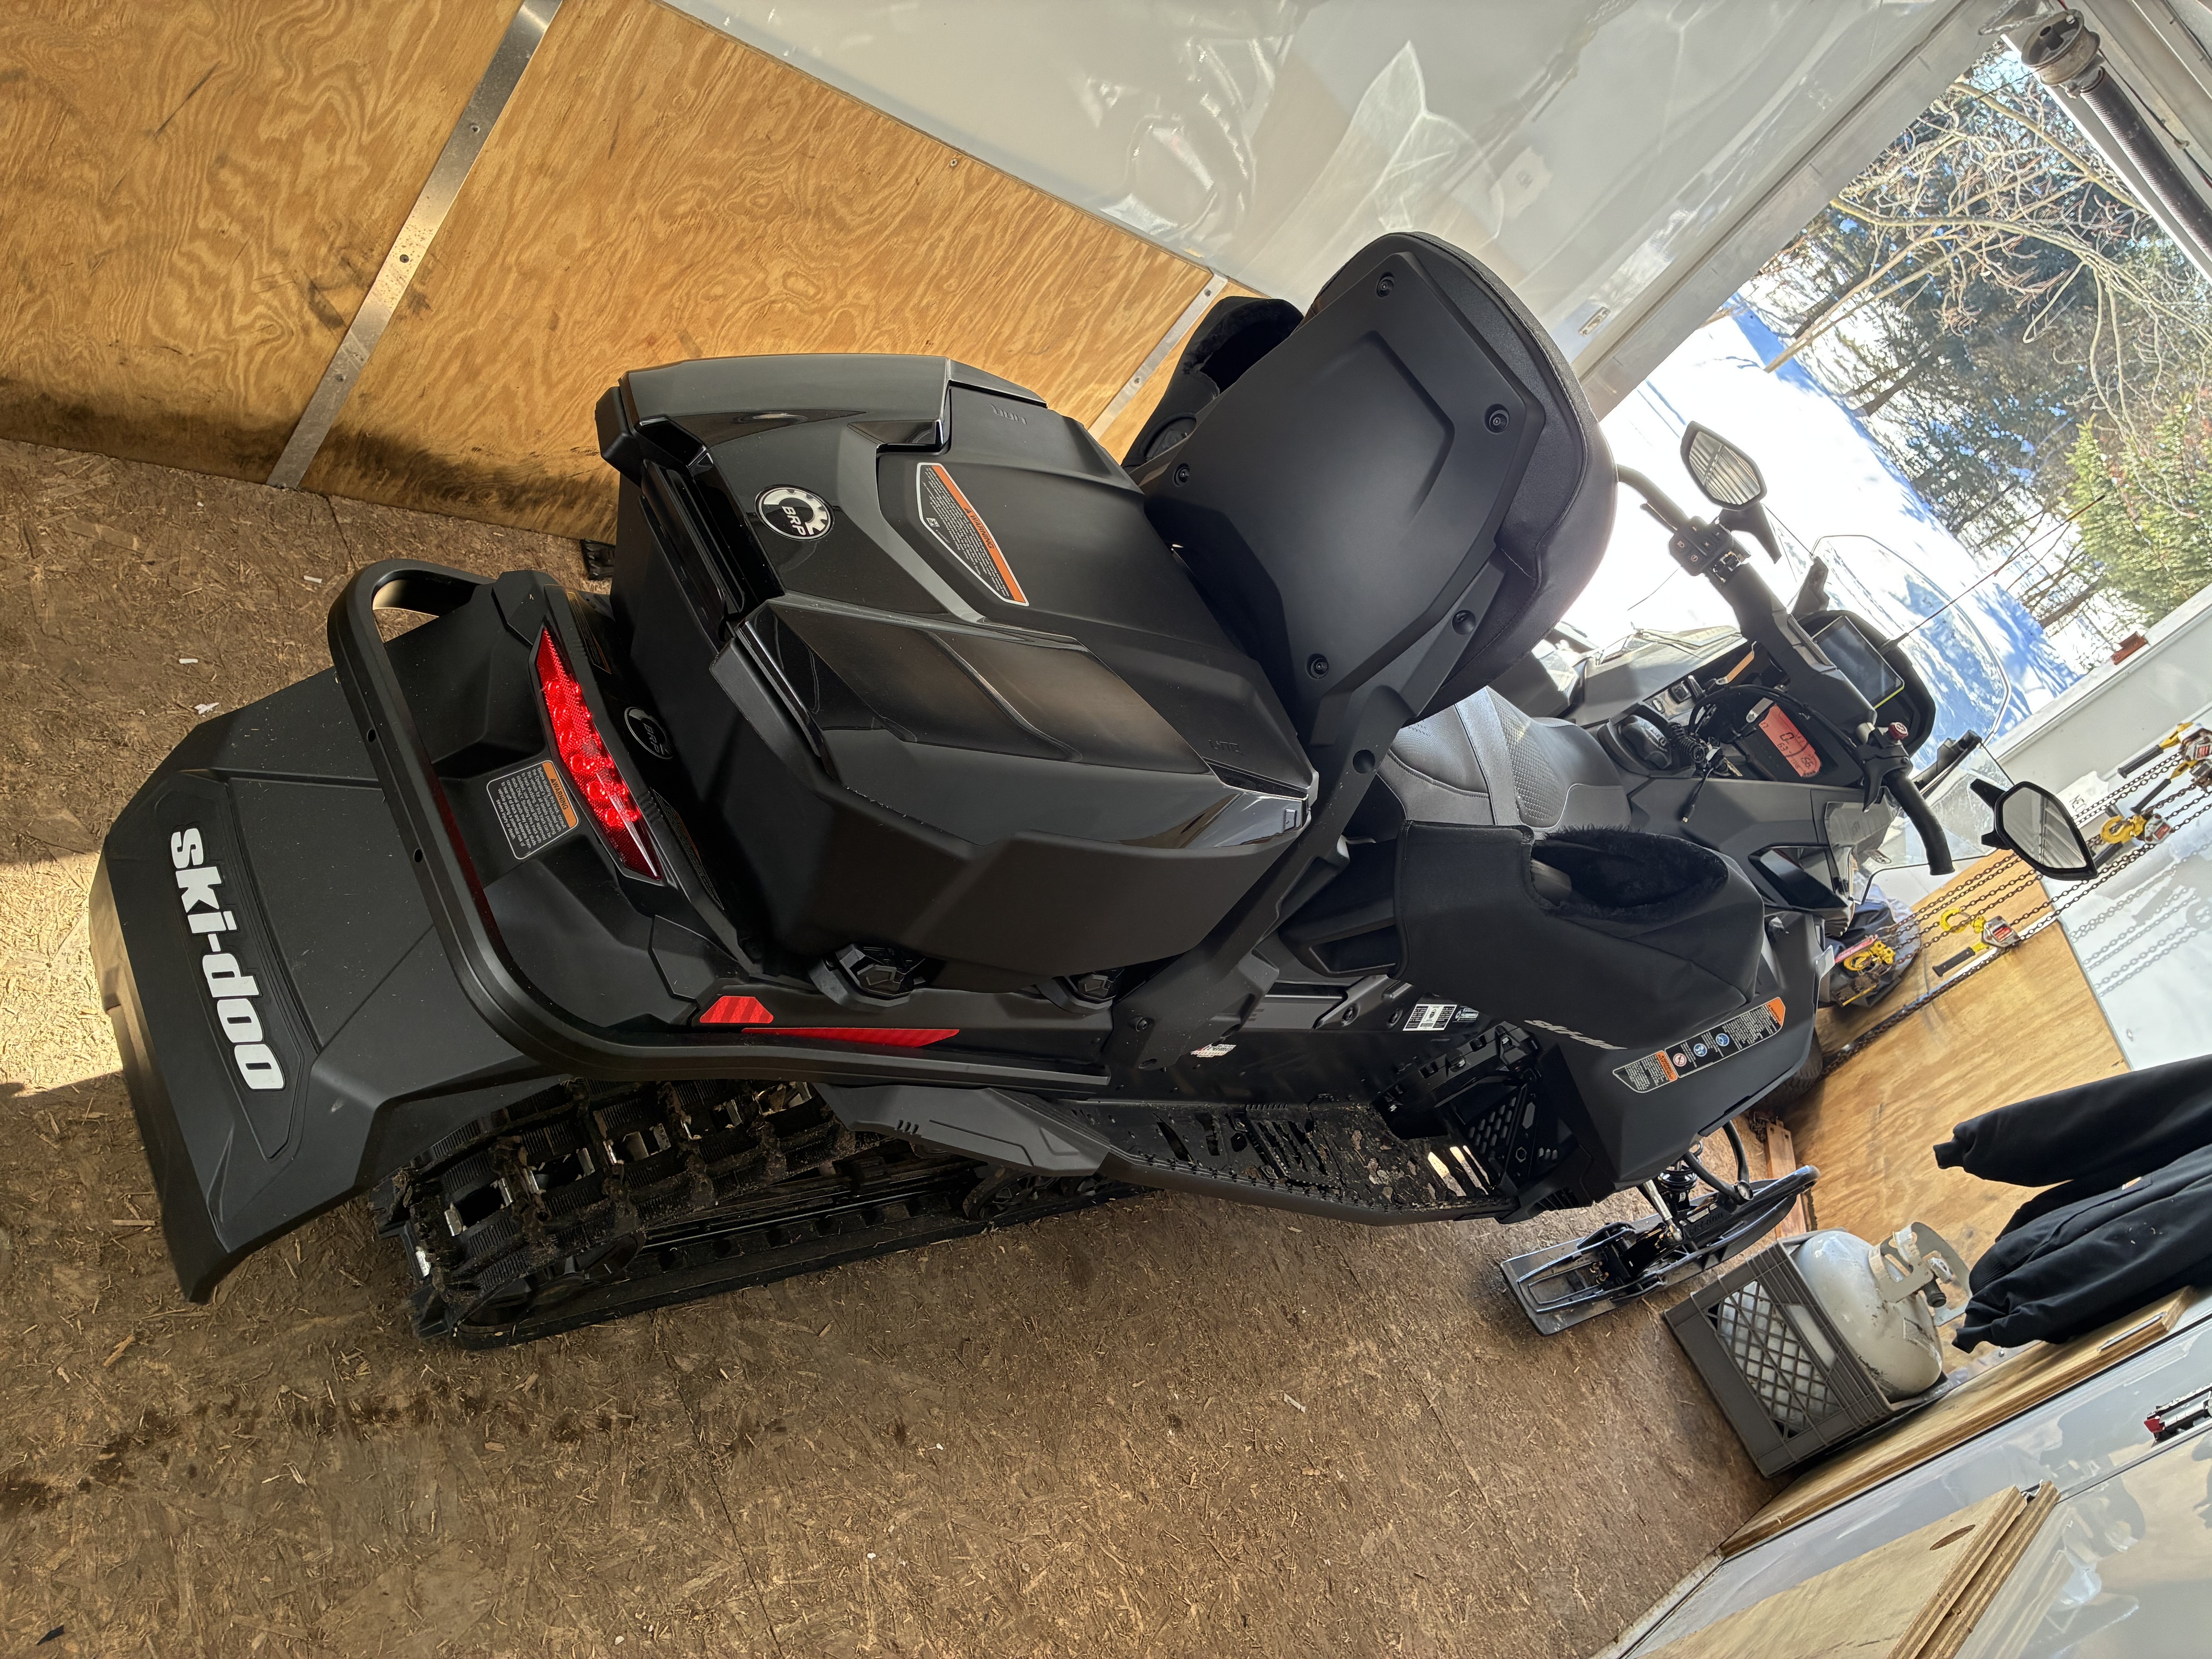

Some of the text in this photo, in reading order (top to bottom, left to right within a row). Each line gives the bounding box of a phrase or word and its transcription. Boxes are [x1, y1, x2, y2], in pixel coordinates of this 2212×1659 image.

[781, 506, 806, 536] BRP
[970, 515, 994, 549] WARNING
[643, 723, 660, 753] BRP
[506, 779, 519, 803] conventional
[529, 778, 539, 792] vehicle
[534, 775, 546, 795] Operator's
[543, 795, 551, 807] Guide
[548, 806, 558, 823] included
[537, 767, 546, 780] Before
[557, 814, 566, 829] consult
[552, 781, 568, 810] WARNING
[495, 799, 504, 812] severe
[500, 812, 509, 824] injury
[497, 787, 507, 802] vehicle
[502, 801, 512, 815] posing
[509, 817, 520, 835] potential
[519, 799, 531, 817] Studding
[526, 799, 535, 813] special
[535, 821, 547, 841] approved
[540, 802, 549, 816] details
[517, 821, 528, 839] separate
[544, 815, 557, 835] pertaining
[171, 828, 285, 1089] ski-doo
